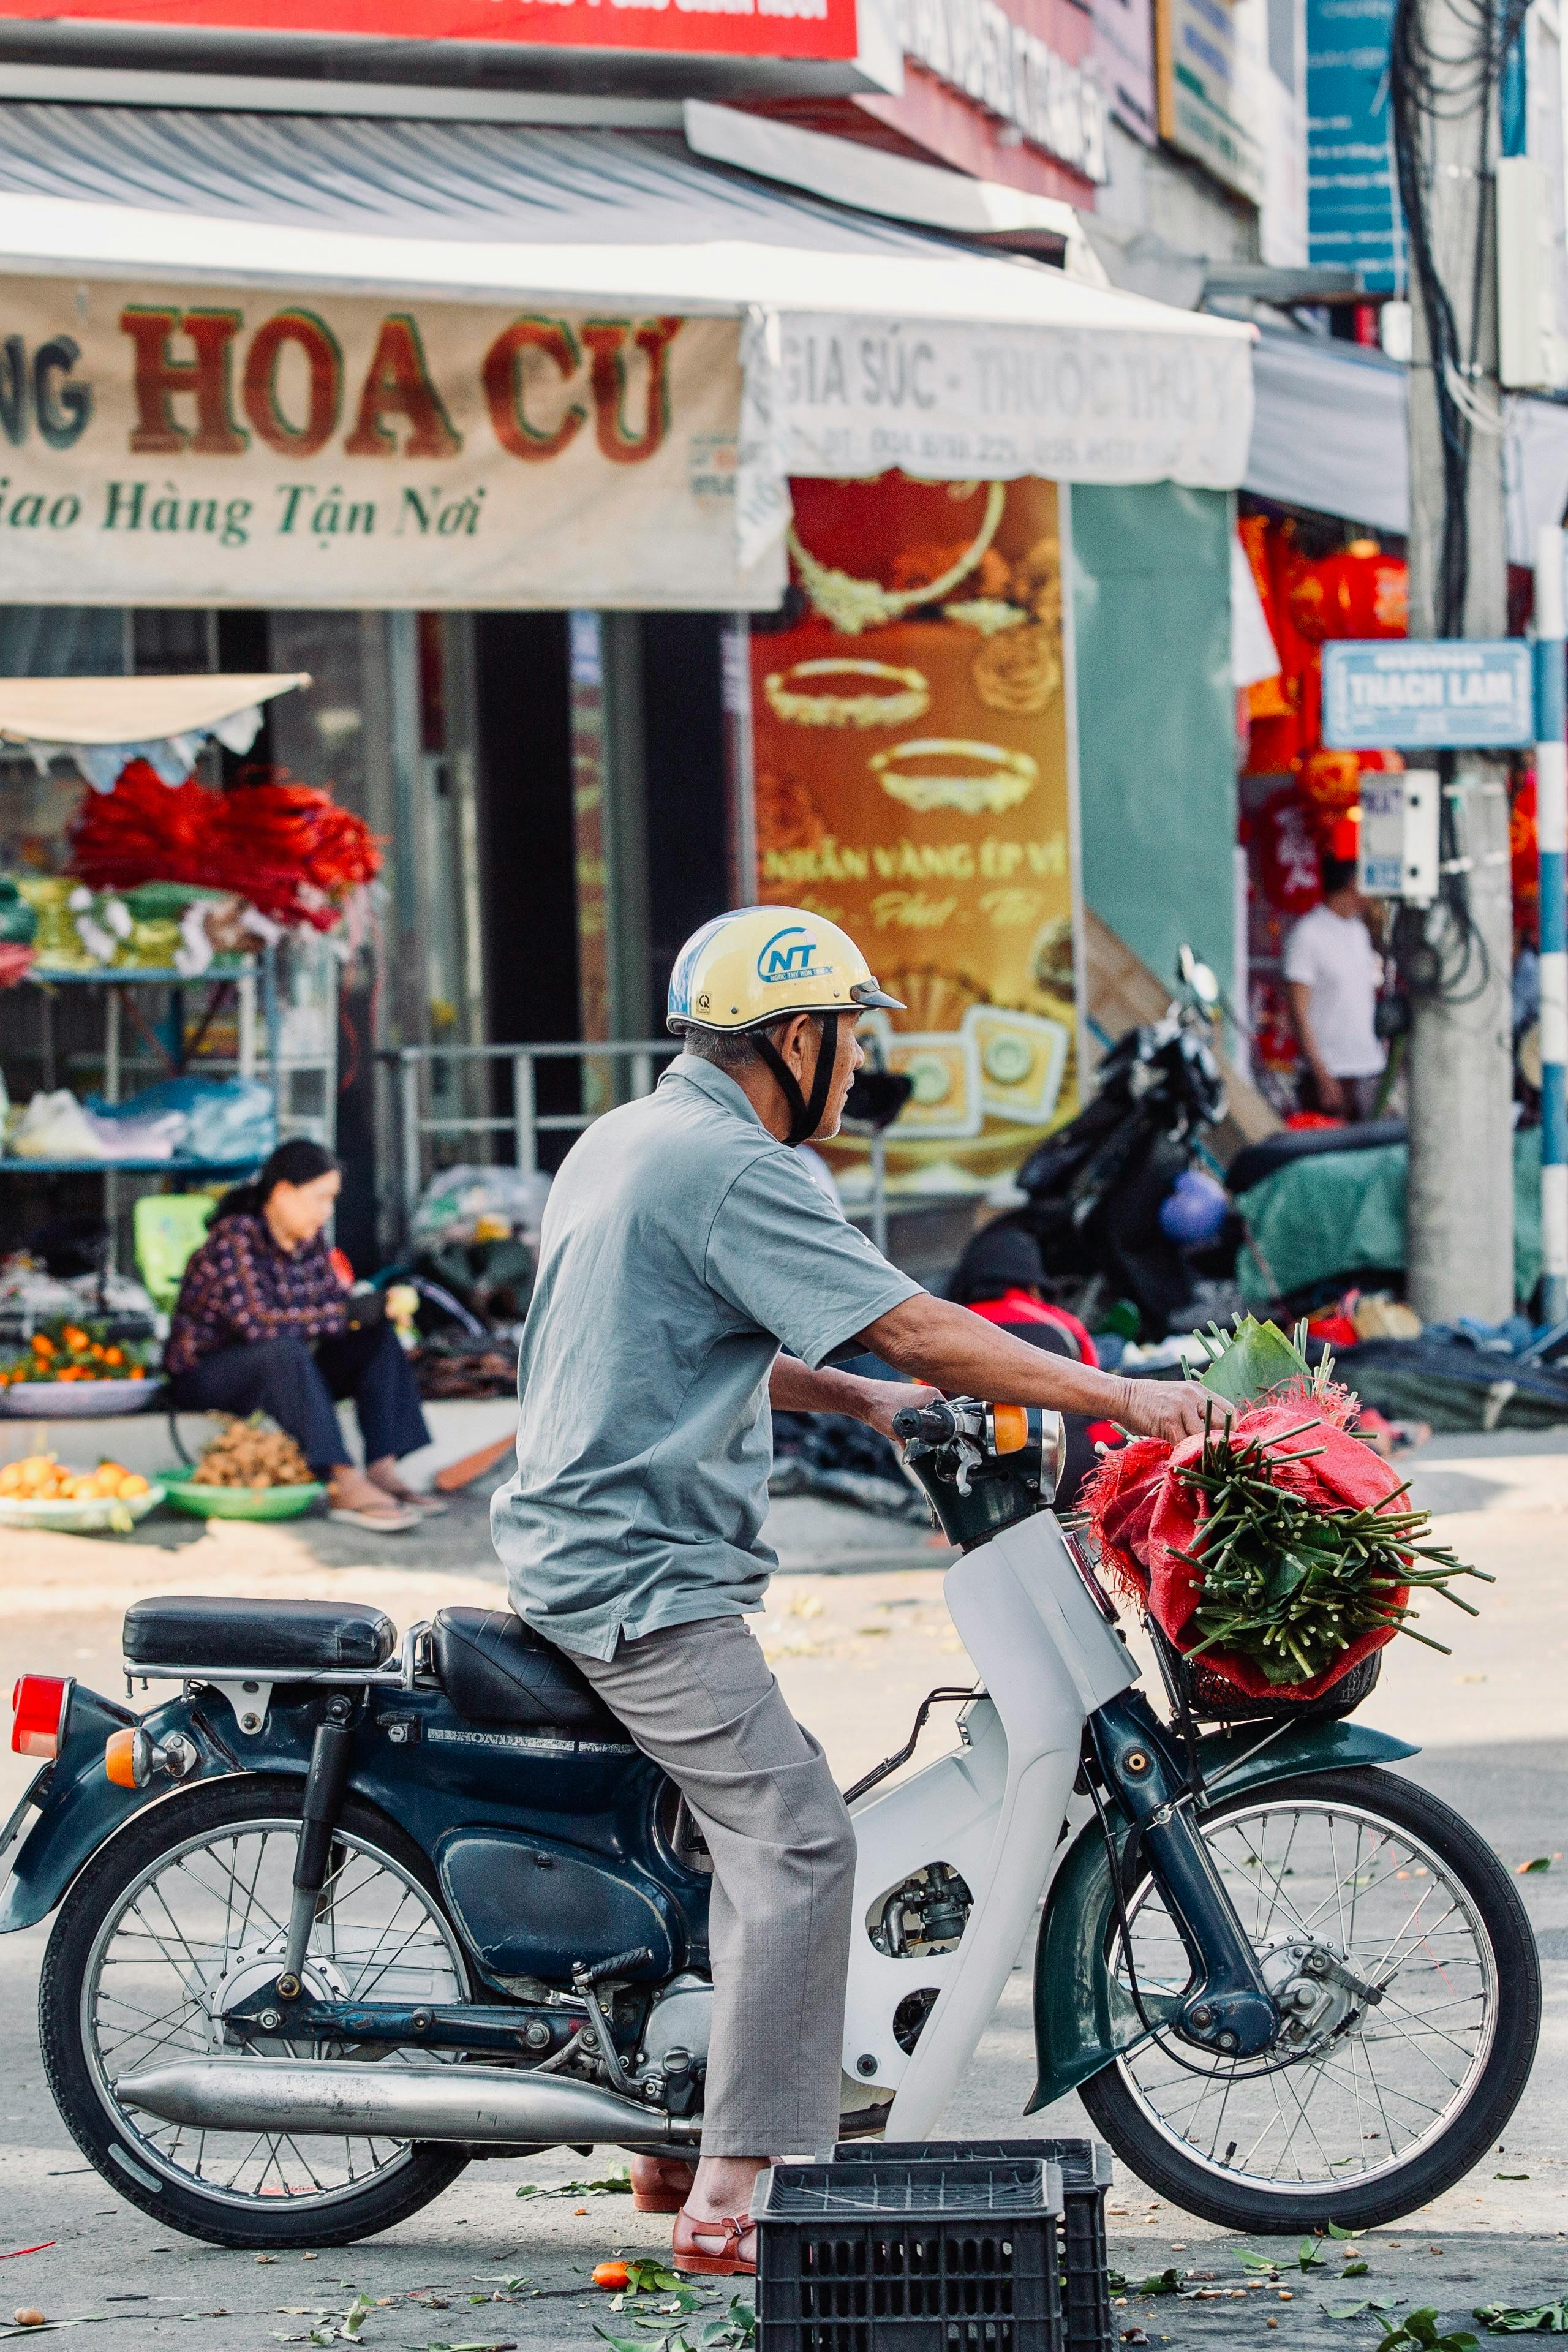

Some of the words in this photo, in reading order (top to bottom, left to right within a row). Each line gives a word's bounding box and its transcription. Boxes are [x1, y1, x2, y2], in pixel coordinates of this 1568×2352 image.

[119, 305, 464, 459] HOA
[859, 322, 937, 410] SÚC
[101, 480, 252, 547] Hàng
[276, 484, 375, 549] Tận
[768, 944, 817, 973] NT
